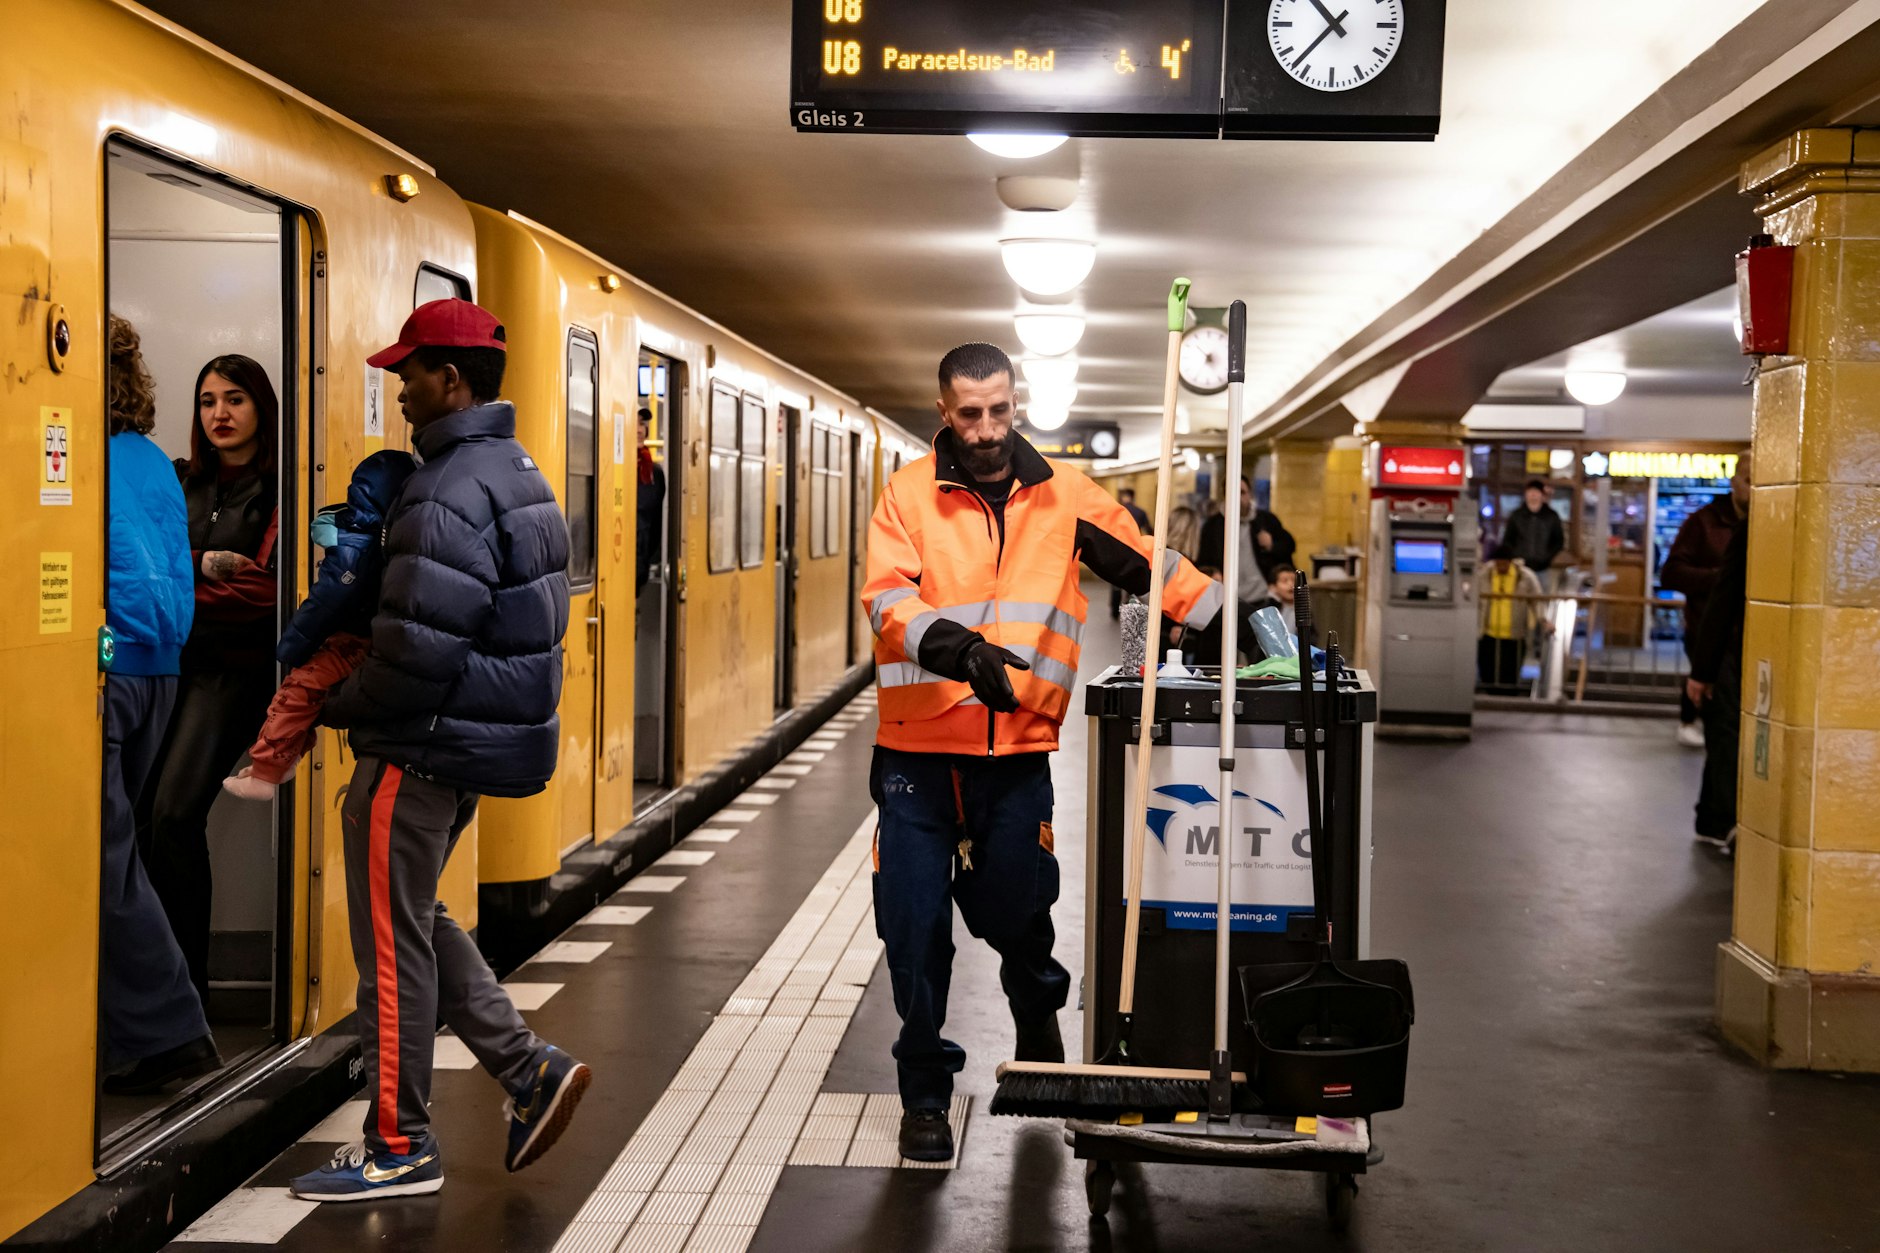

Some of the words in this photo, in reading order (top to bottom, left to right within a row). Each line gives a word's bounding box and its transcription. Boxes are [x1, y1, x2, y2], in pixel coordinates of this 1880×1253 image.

[825, 0, 862, 23] U8
[824, 41, 861, 74] U8
[883, 47, 1054, 72] Paracelsus-Bad
[797, 109, 847, 127] Gleis
[853, 111, 865, 127] 2
[1608, 451, 1739, 479] MINIMARKT
[1275, 862, 1290, 870] und
[1291, 863, 1312, 872] Logist
